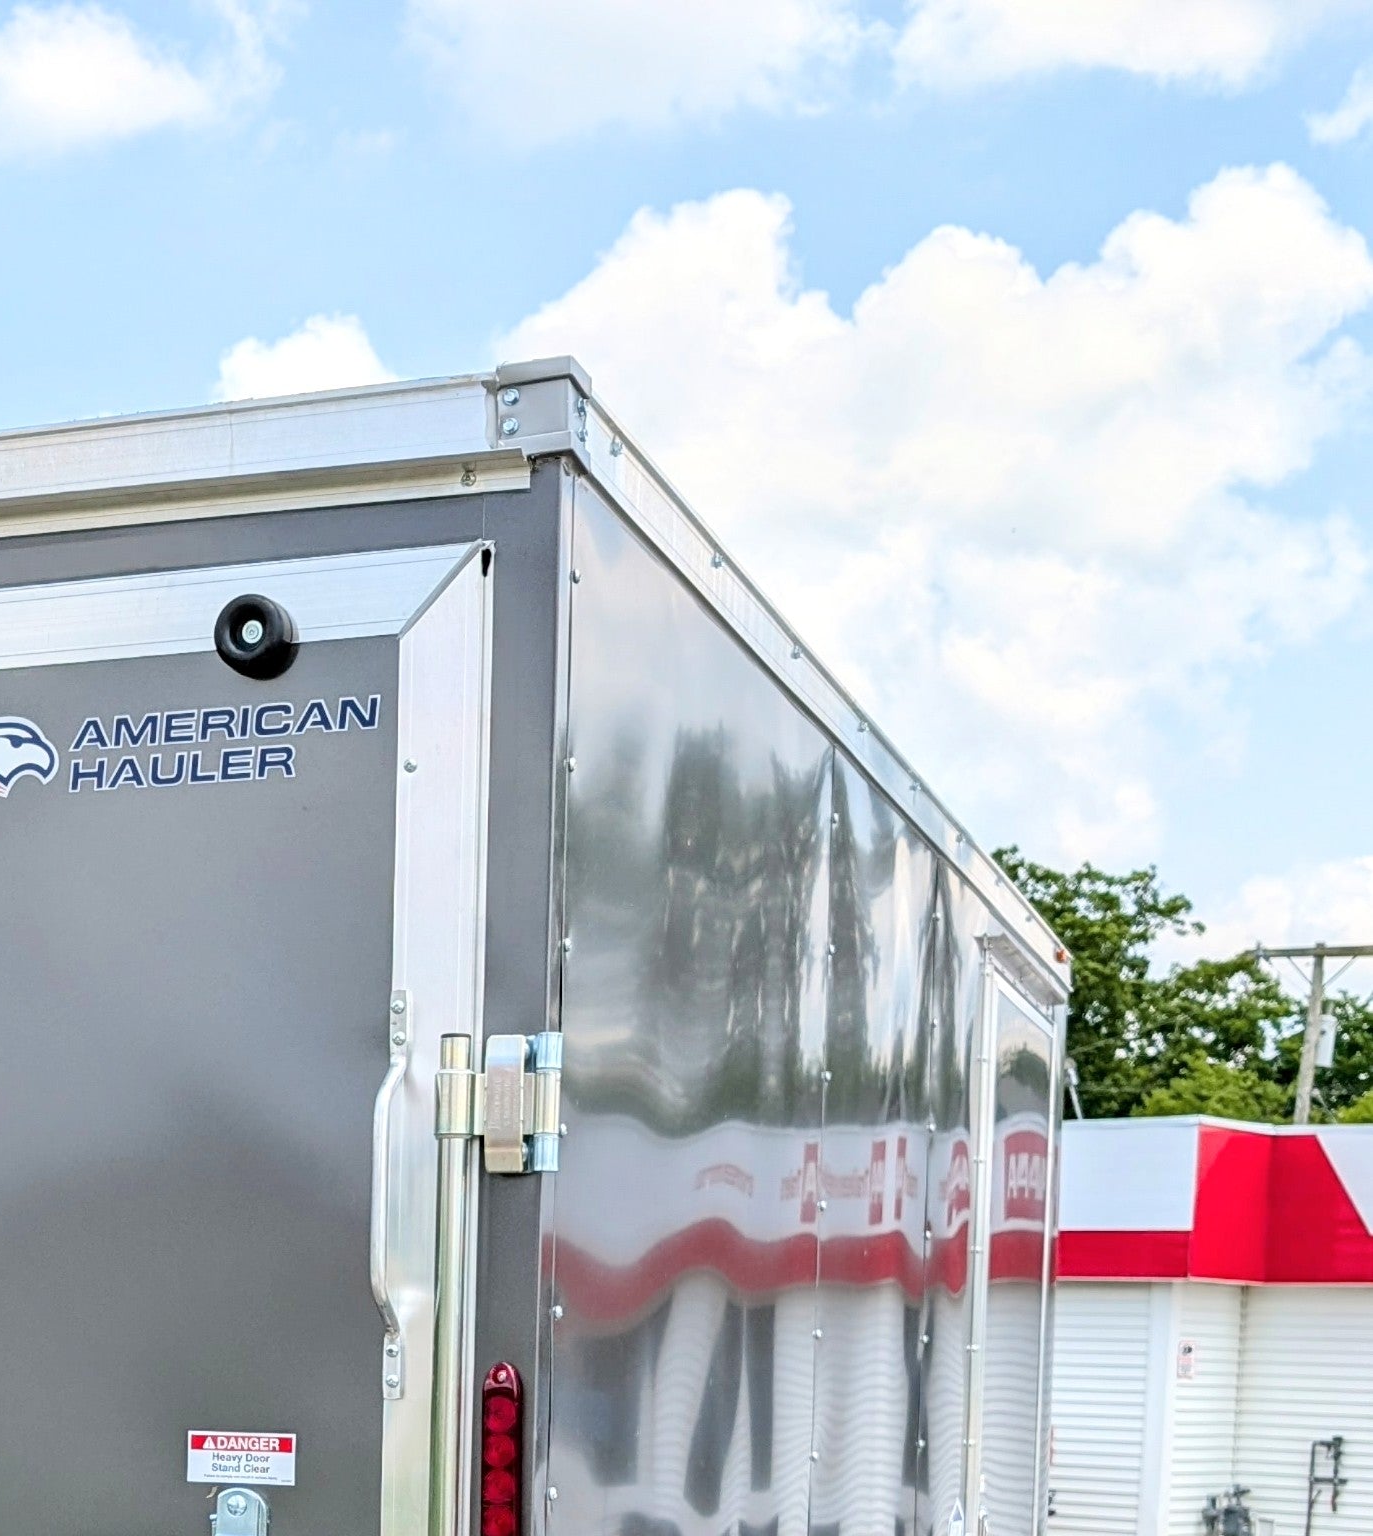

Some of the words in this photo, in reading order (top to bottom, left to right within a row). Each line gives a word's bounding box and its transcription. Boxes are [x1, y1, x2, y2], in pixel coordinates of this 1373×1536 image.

[70, 694, 381, 751] AMERICAN
[69, 745, 296, 793] HAULER
[217, 1437, 280, 1451] DANGER
[212, 1452, 243, 1463] Heavy
[246, 1454, 271, 1463] Door
[212, 1463, 241, 1473] Stand
[243, 1464, 271, 1474] Clear
